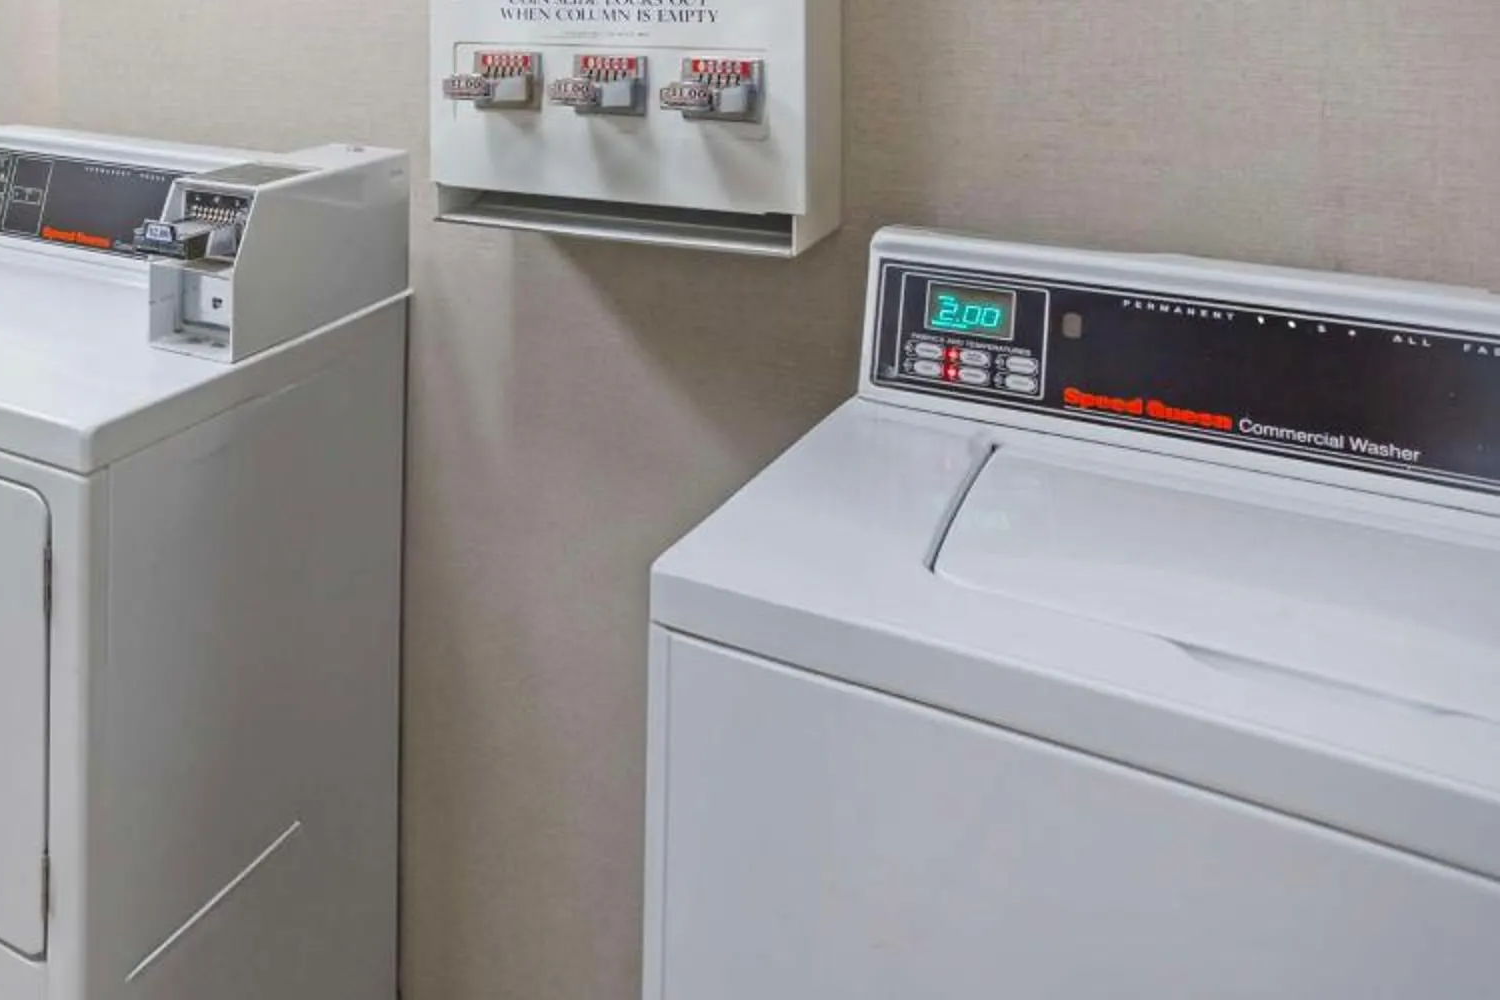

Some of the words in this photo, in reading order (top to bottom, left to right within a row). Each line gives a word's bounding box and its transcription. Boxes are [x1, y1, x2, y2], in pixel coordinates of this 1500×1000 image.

[500, 7, 550, 21] WHEN
[555, 7, 630, 22] COLUMN
[637, 8, 651, 22] IS
[657, 8, 718, 23] EMPTY
[1123, 298, 1236, 321] PERMANENT
[1393, 334, 1432, 347] ALL
[1062, 386, 1143, 416] Speed
[1238, 418, 1346, 449] Commercial
[1349, 435, 1422, 463] Washer
